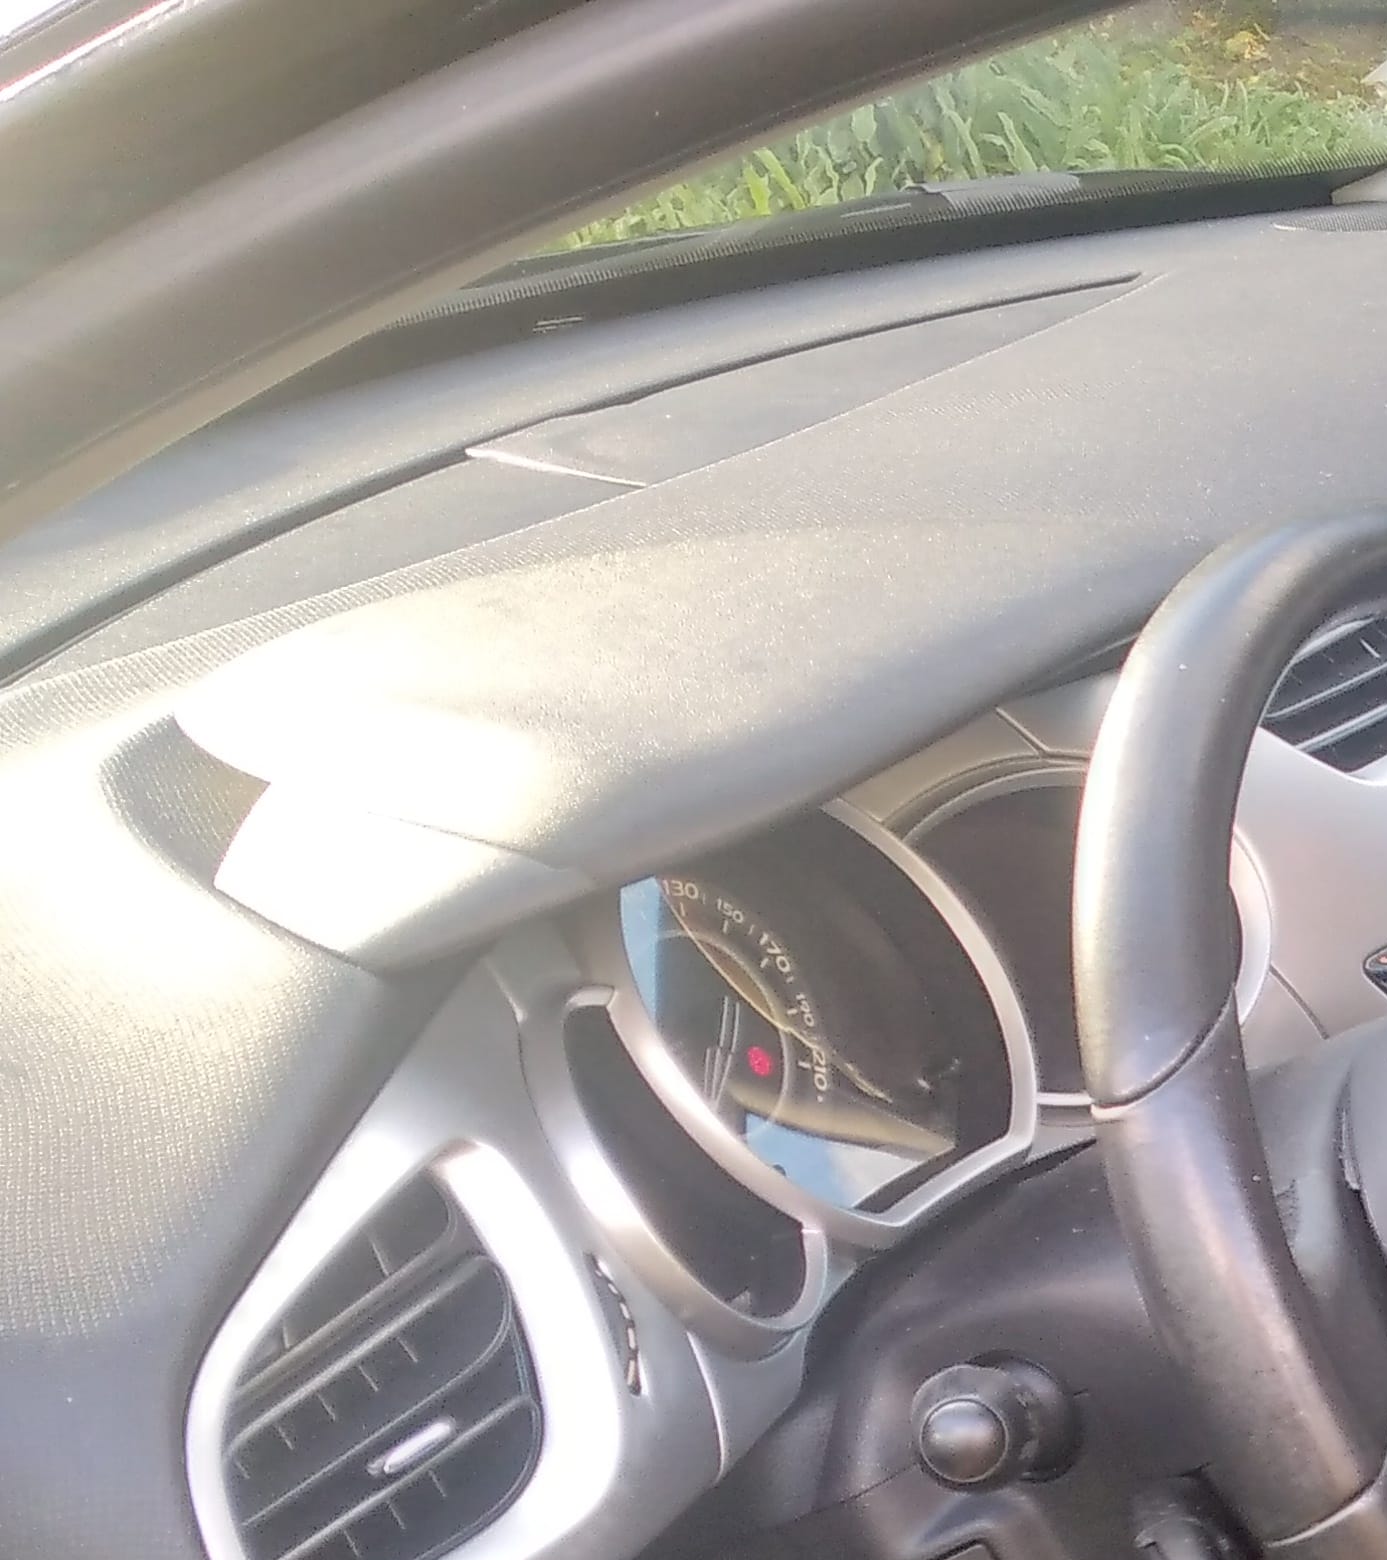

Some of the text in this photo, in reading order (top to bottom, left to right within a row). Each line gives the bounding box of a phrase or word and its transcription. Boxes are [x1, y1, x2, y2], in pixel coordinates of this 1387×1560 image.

[662, 879, 699, 899] 130
[717, 898, 744, 924] 150
[760, 932, 791, 973] 170
